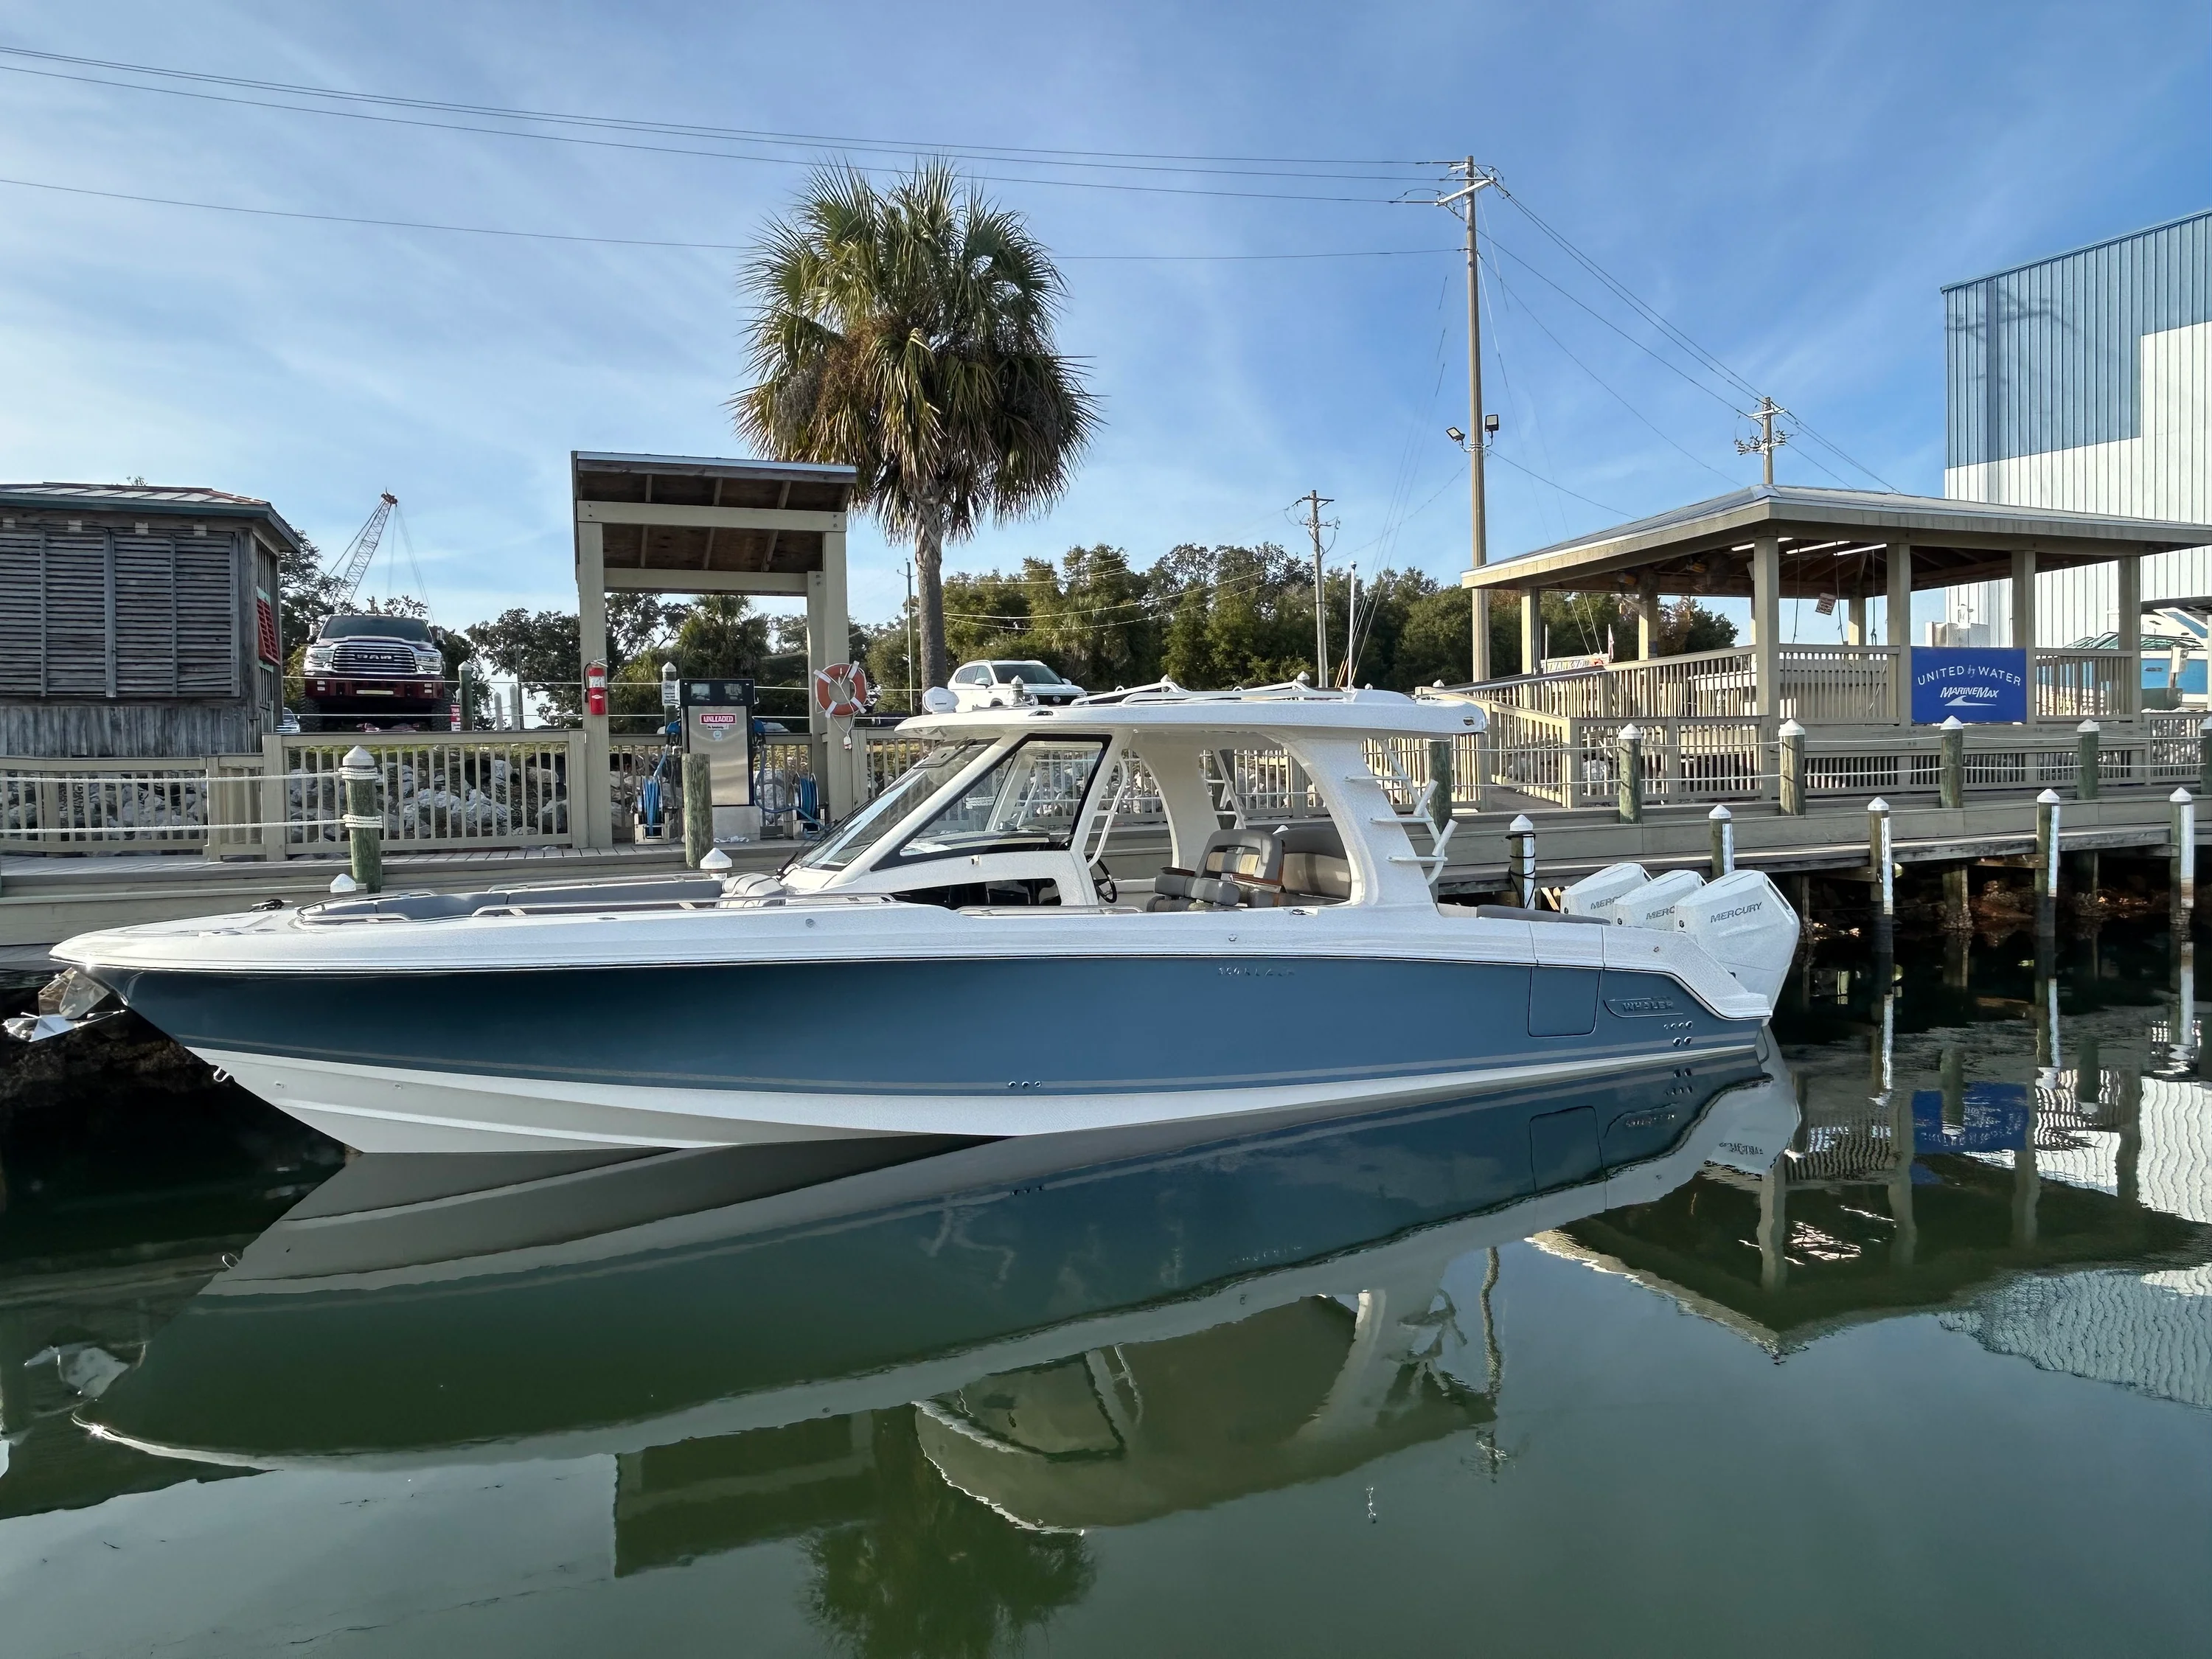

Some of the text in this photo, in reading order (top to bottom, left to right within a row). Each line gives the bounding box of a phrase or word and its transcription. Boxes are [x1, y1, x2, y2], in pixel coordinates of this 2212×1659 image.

[1917, 664, 2021, 686] UNITED by WATER
[1710, 901, 1762, 923] MERCURY
